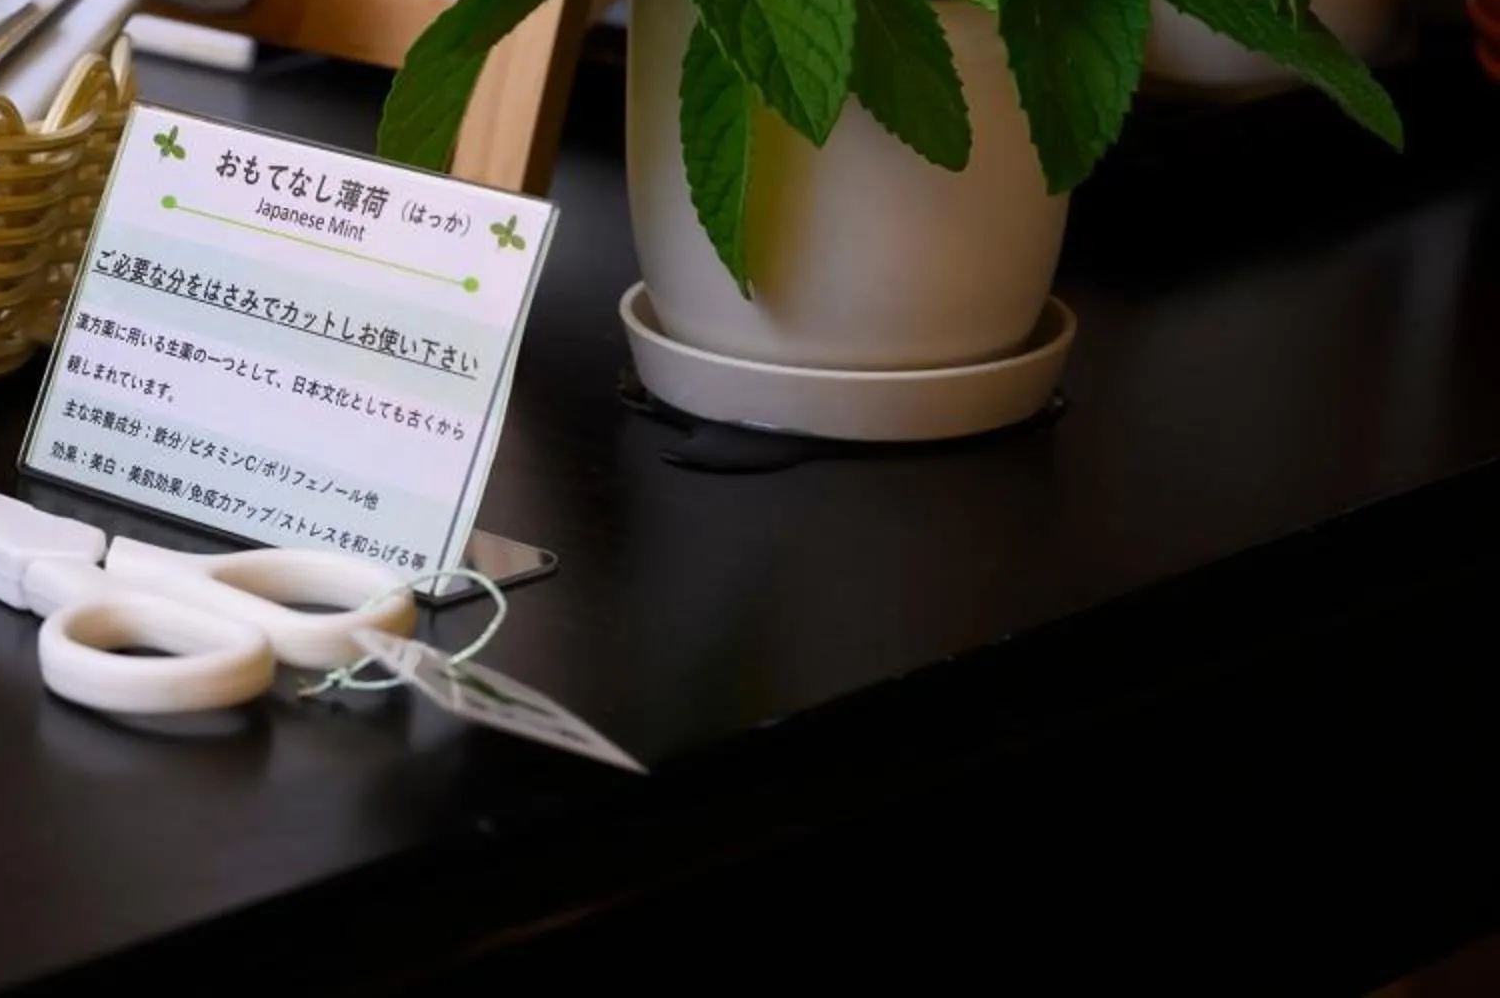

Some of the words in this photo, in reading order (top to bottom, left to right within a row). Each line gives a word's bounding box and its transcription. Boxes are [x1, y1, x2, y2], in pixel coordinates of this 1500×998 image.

[255, 197, 325, 231] Japanese
[328, 216, 366, 242] Mint
[94, 249, 479, 373] ご必要な分をはさみでカットしお使い下さい
[66, 354, 174, 403] 親しまれています。
[74, 311, 465, 441] 漢方薬に用いる生薬の一つとして、日本文化としても古くから
